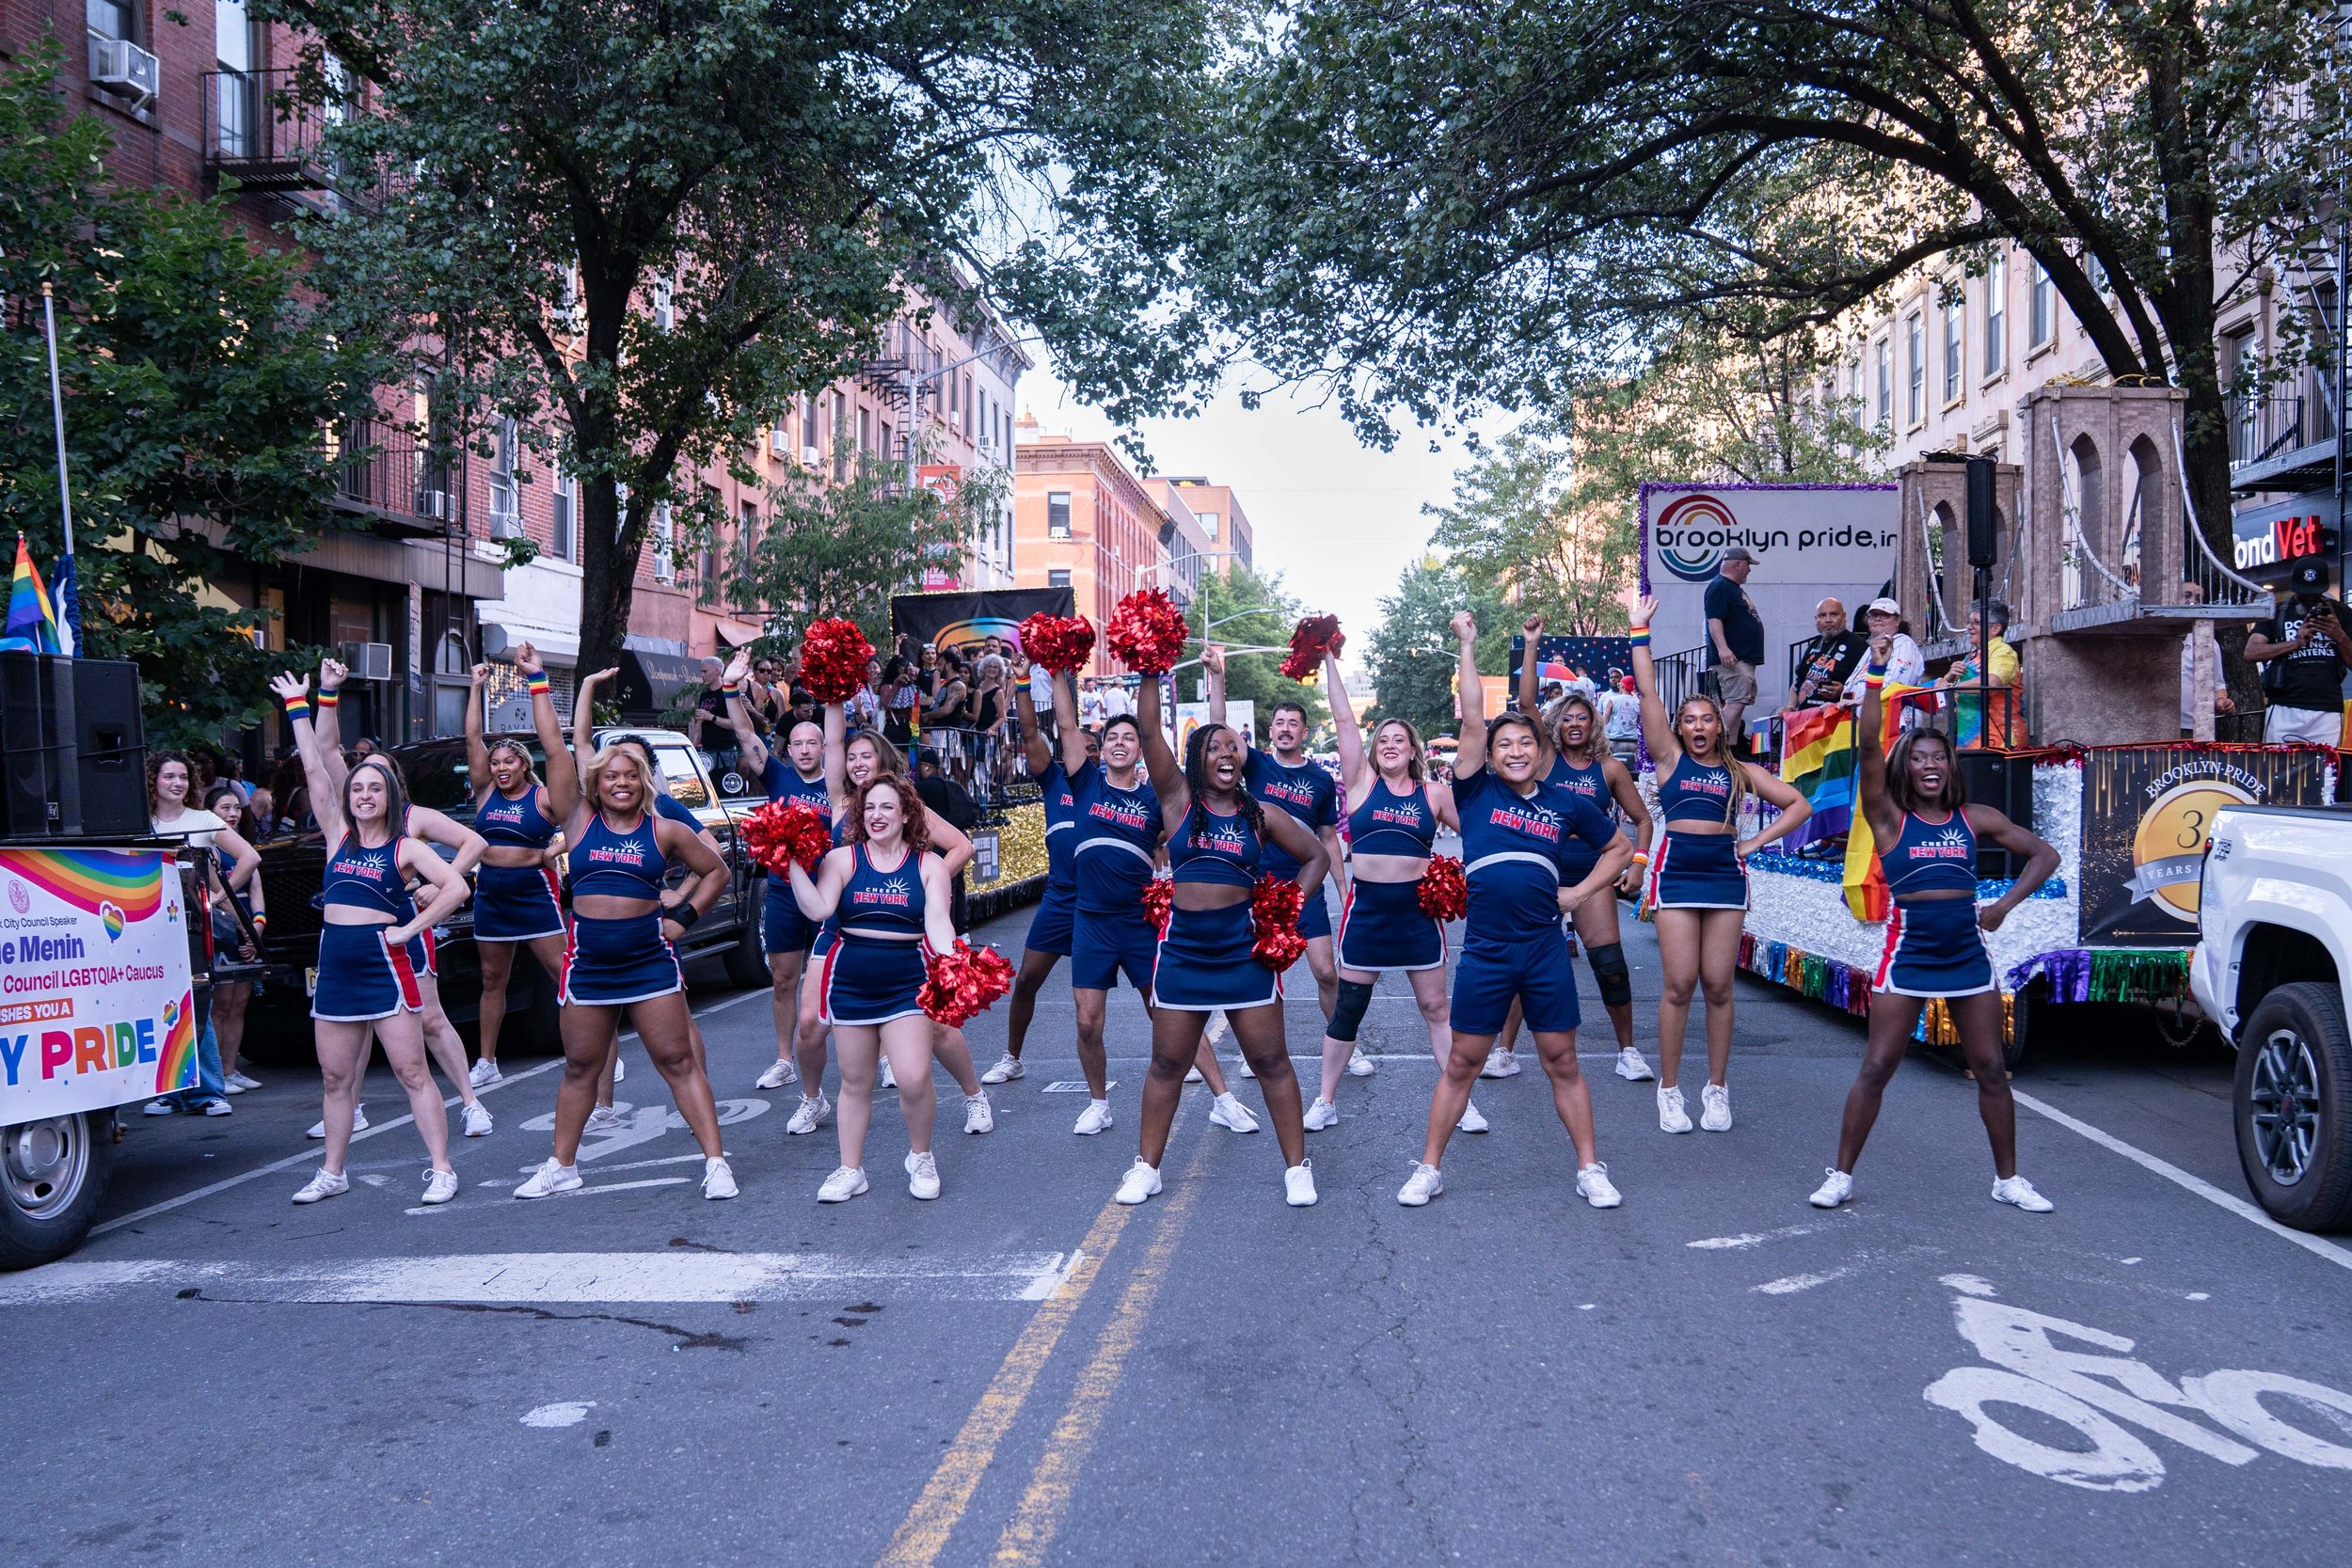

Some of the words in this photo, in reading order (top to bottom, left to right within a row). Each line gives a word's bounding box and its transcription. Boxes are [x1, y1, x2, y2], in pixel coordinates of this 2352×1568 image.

[1656, 527, 1788, 552] brooklyn
[1277, 782, 1304, 794] CHEER
[1680, 779, 1701, 791] NEW
[1702, 784, 1727, 797] YORK
[1691, 776, 1719, 785] CHEER
[801, 794, 827, 805] CHEER
[1060, 794, 1073, 806] NE
[1264, 783, 1288, 799] NEW
[1288, 791, 1313, 808] YORK
[787, 795, 810, 808] NEW
[810, 802, 833, 817] YORK
[1104, 802, 1136, 814] CHEER
[1384, 807, 1411, 816] CHEER
[1509, 806, 1549, 823] CHEER
[486, 812, 501, 821] NEW
[502, 814, 522, 824] YORK
[1089, 803, 1116, 821] NEW
[1116, 812, 1146, 831] YORK
[1372, 810, 1395, 822] NEW
[1395, 814, 1419, 828] YORK
[1490, 808, 1524, 830] NEW
[1525, 818, 1560, 843] YORK
[1201, 832, 1232, 841] CHEER
[1214, 839, 1243, 856] YORK
[1909, 847, 1936, 859] NEW
[1938, 846, 1968, 859] YORK
[345, 858, 374, 868] CHEER
[589, 849, 614, 862] NEW
[615, 853, 643, 866] YORK
[333, 862, 355, 874] NEW
[356, 866, 383, 882] YORK
[2146, 864, 2192, 880] YEARS
[854, 891, 879, 903] NEW
[880, 893, 908, 907] YORK
[4, 918, 20, 930] City
[21, 916, 49, 927] Council
[50, 916, 77, 927] Speaker
[20, 933, 85, 963] Menin
[4, 970, 58, 994] Council
[62, 966, 124, 987] LGBTQIA+
[126, 964, 164, 982] Caucus
[34, 1004, 58, 1018] YOU
[61, 1001, 70, 1015] A
[42, 1018, 157, 1079] PRIDE
